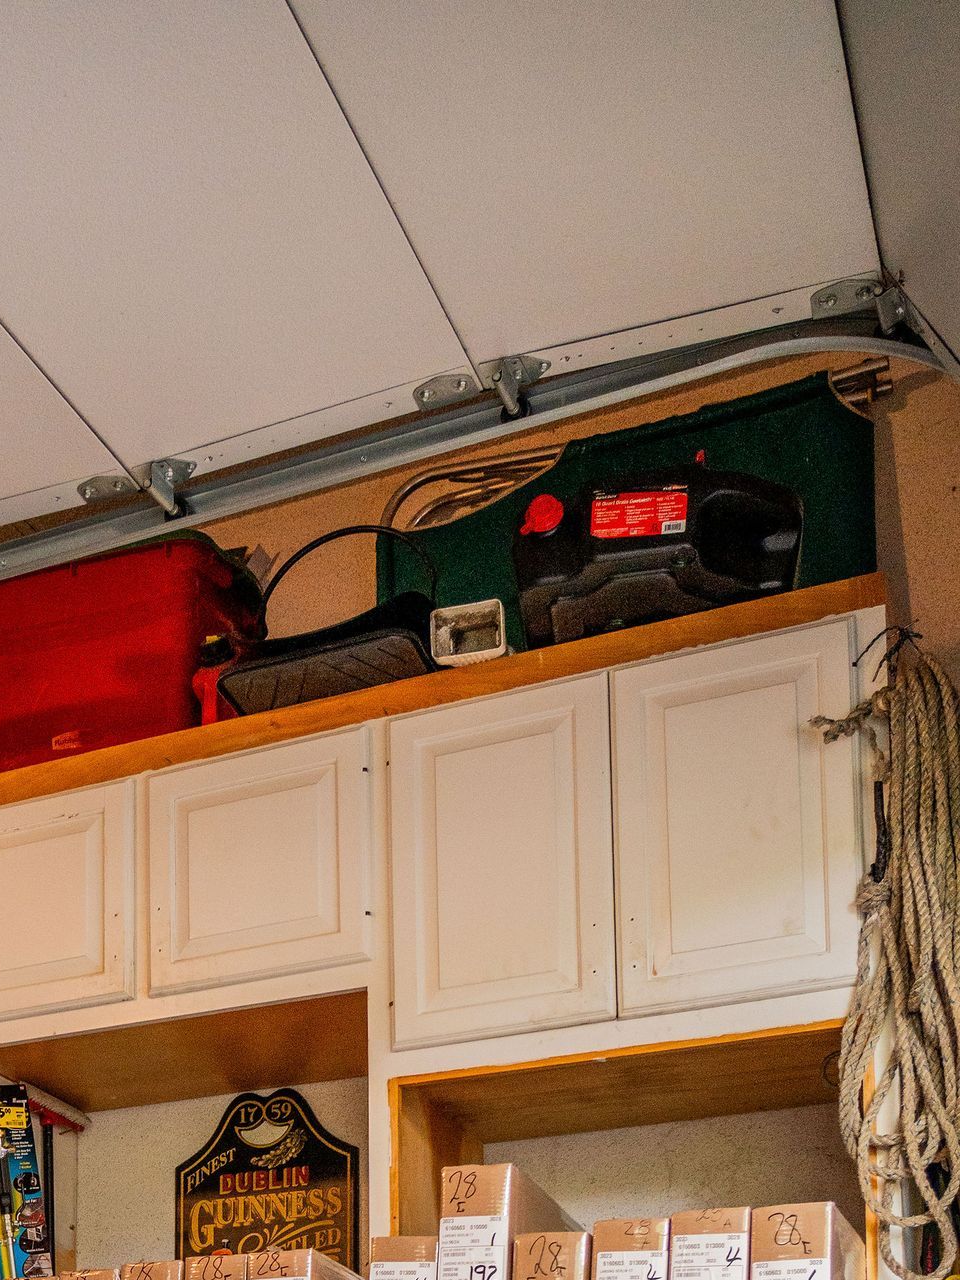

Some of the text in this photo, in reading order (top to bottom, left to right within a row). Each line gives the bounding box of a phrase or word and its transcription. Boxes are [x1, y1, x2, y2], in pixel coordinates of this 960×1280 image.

[240, 1102, 291, 1124] 17 59
[186, 1148, 236, 1194] FINEST
[219, 1166, 309, 1194] DUBLIN
[448, 1170, 477, 1204] 28
[191, 1187, 342, 1252] GUINNESS
[768, 1212, 801, 1245] 28
[257, 1252, 281, 1275] 28
[725, 1246, 742, 1267] 4
